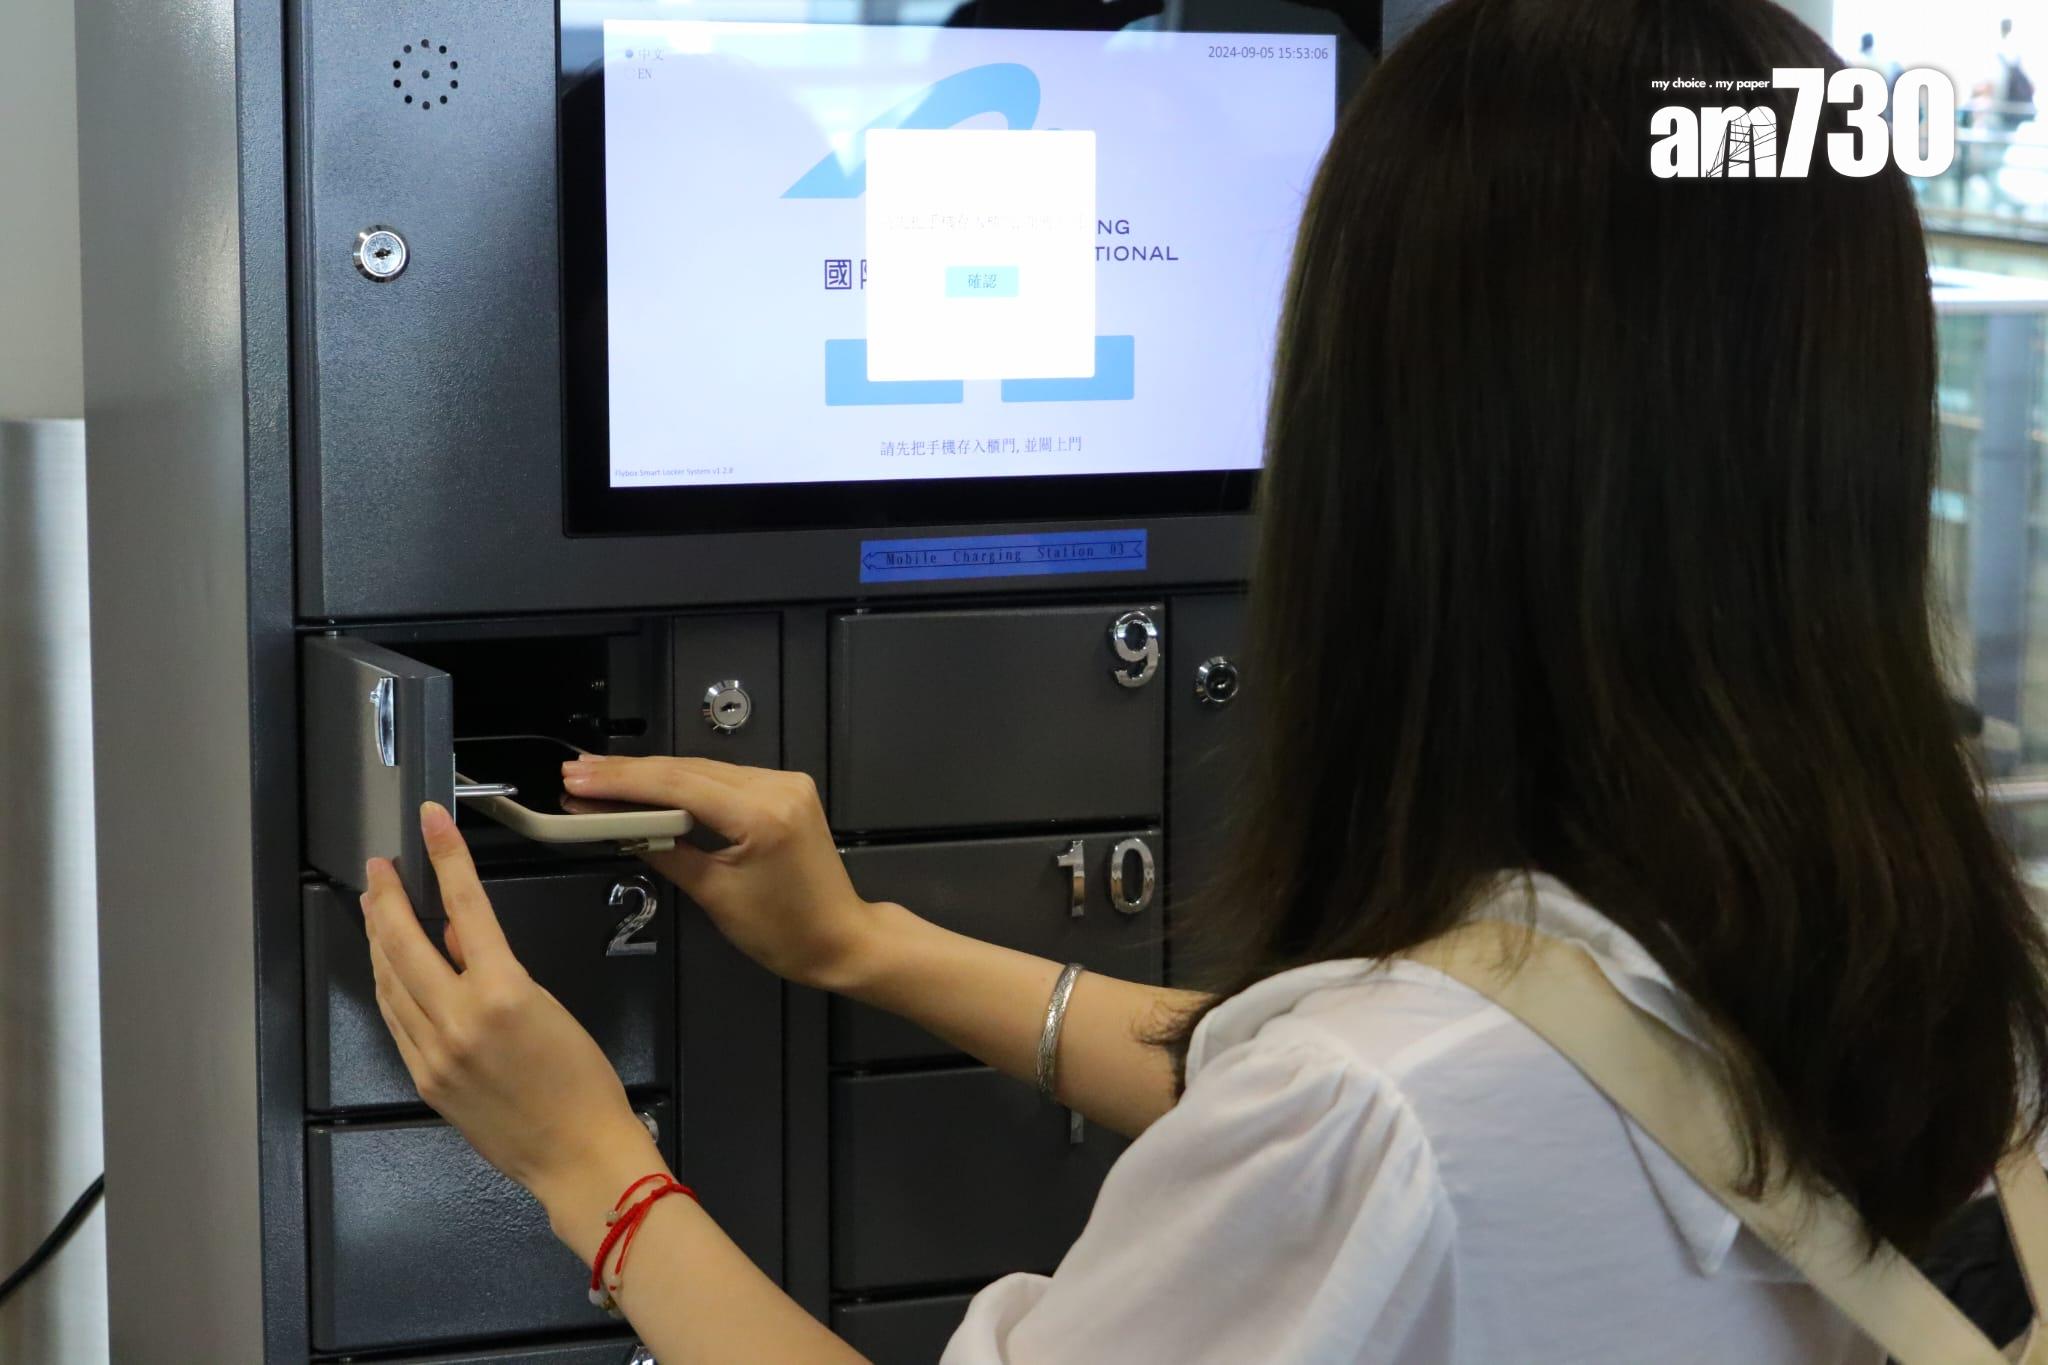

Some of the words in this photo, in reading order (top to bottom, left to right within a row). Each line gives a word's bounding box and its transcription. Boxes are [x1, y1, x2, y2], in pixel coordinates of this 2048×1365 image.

[638, 48, 664, 61] 中文
[1208, 46, 1274, 58] 2024-09-05
[1278, 47, 1329, 60] 15:53:06
[638, 67, 653, 80] EN
[967, 273, 998, 290] 確認
[885, 550, 938, 567] Mobile
[952, 547, 1023, 566] Charging
[1037, 542, 1095, 560] Station
[1108, 541, 1125, 558] 03
[1113, 610, 1160, 688] 9
[1056, 838, 1156, 917] 10
[606, 875, 658, 957] 2
